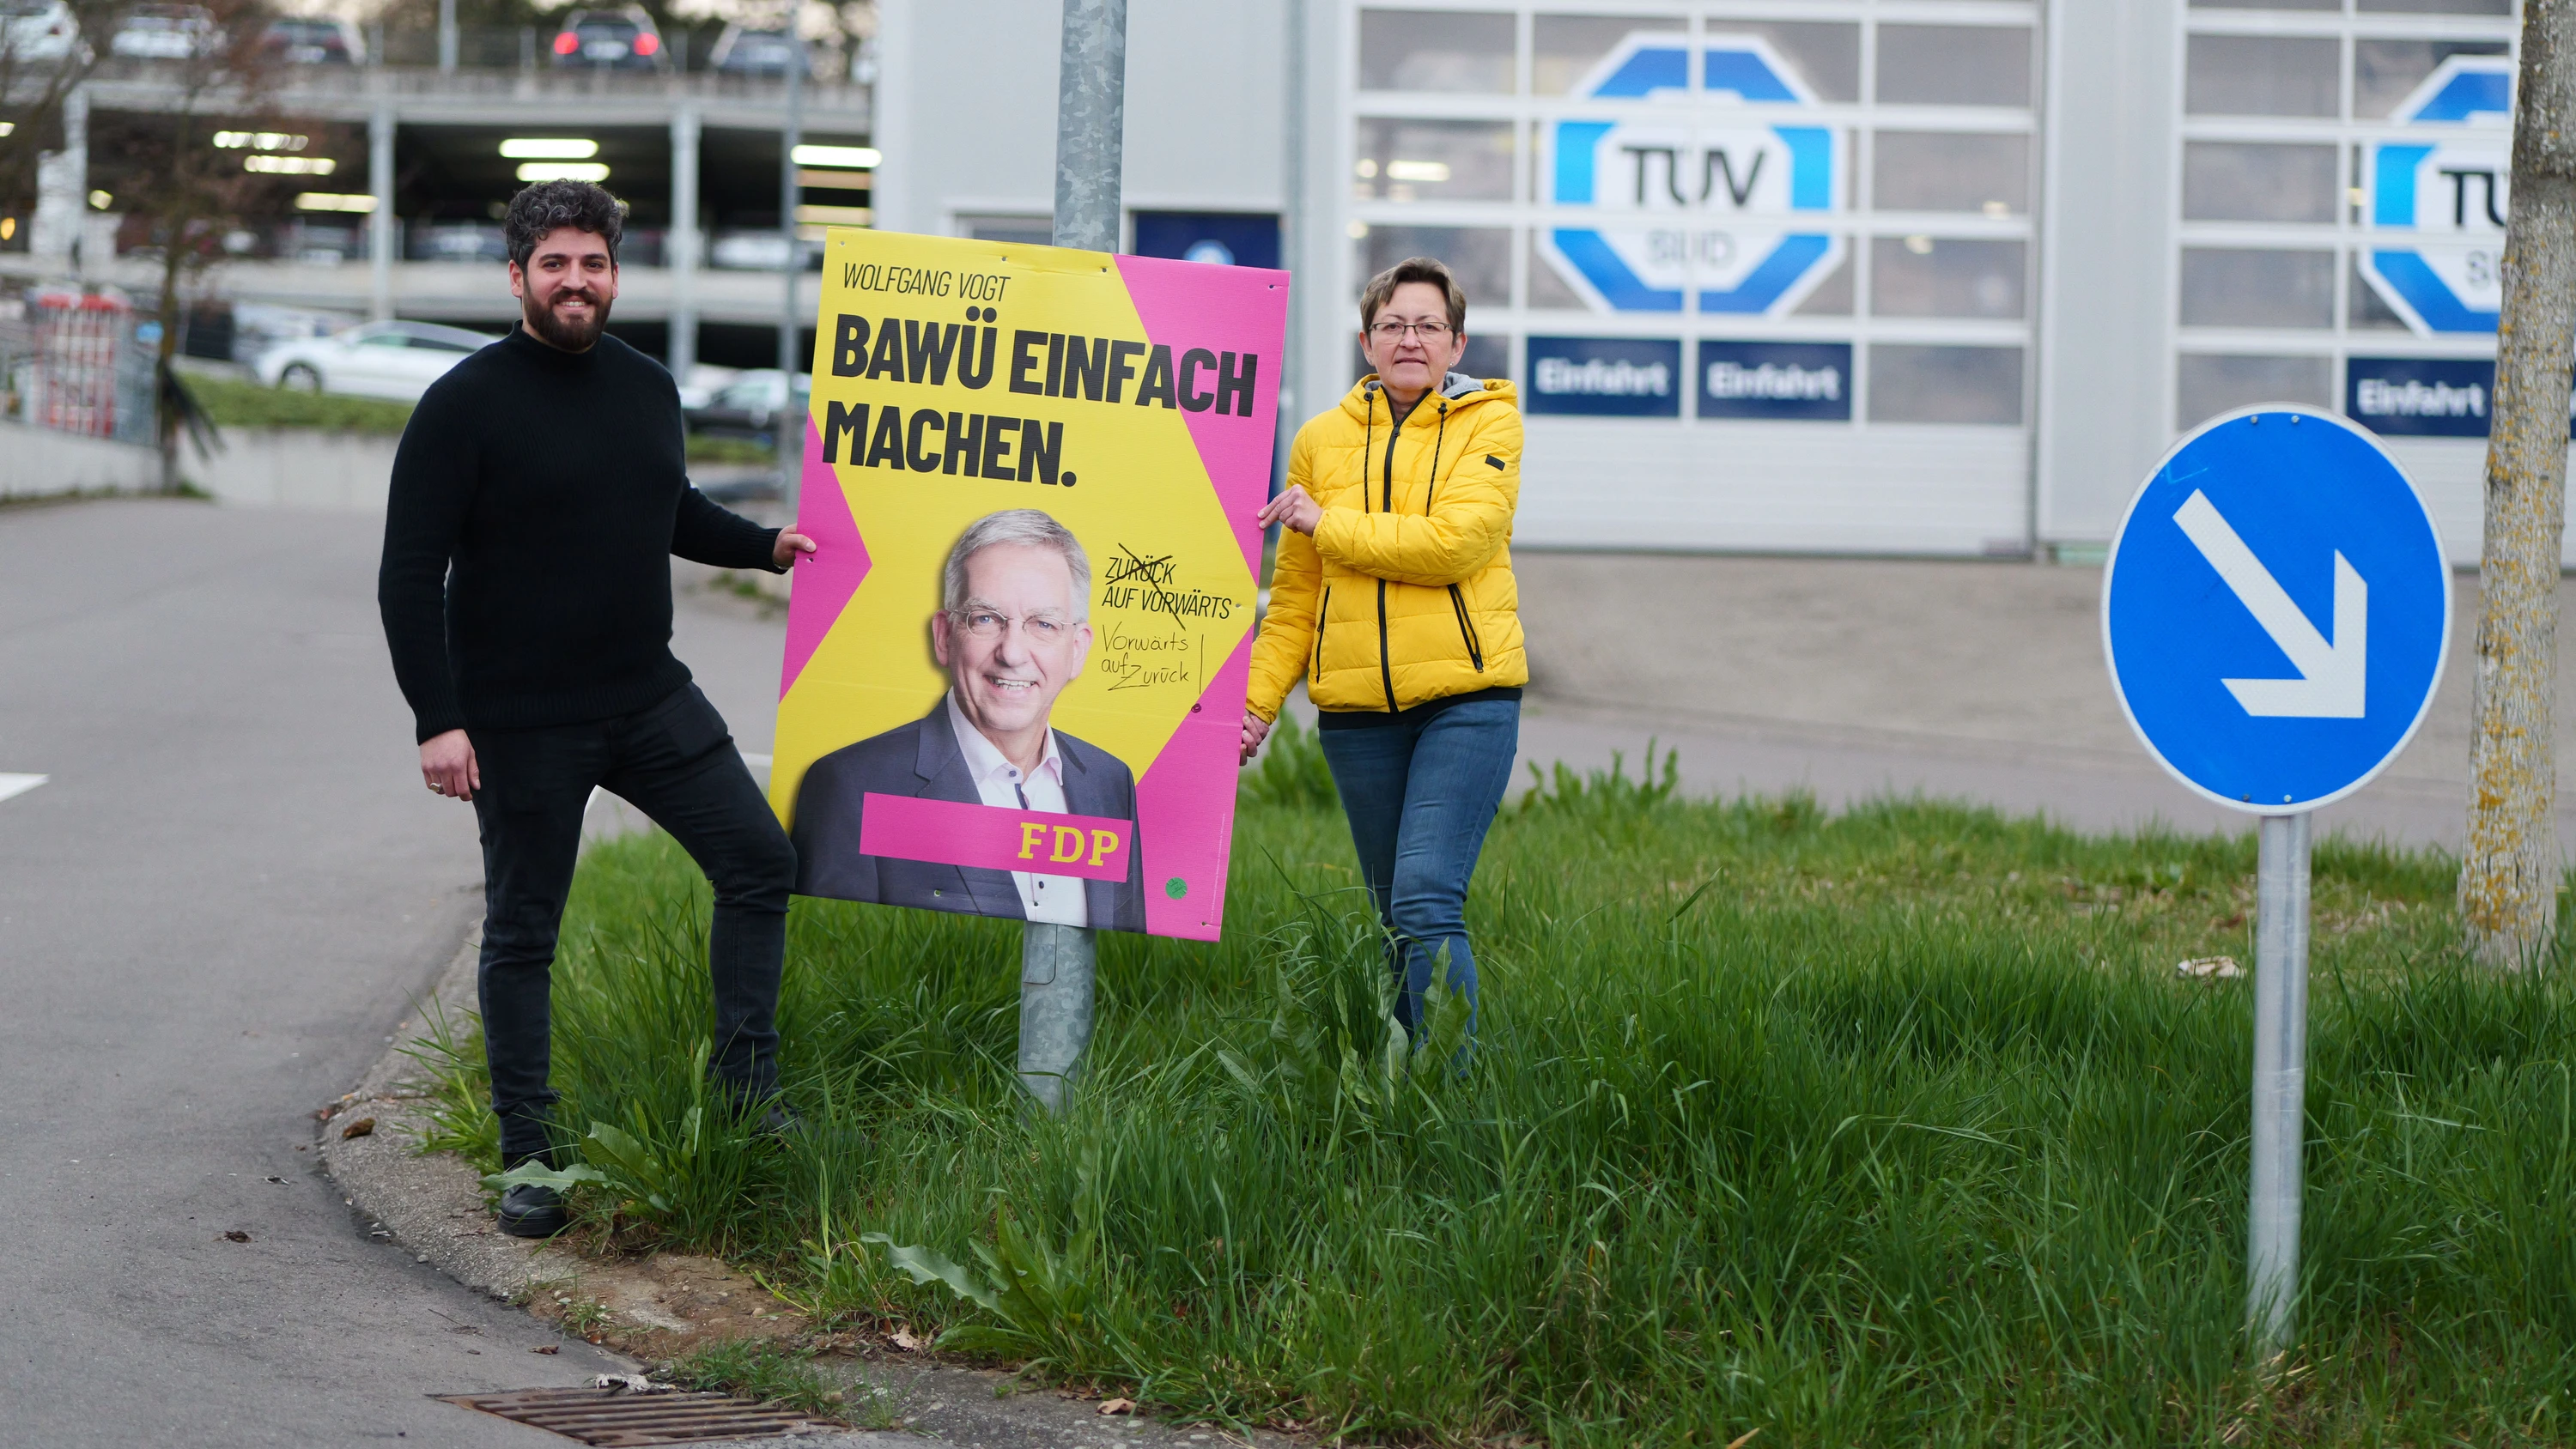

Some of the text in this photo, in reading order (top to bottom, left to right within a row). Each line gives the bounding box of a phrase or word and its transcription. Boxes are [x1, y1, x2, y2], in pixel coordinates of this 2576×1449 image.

[844, 262, 1012, 302] WOLFGANG VOGT
[831, 306, 1258, 418] BAWÜ EINFACH
[1535, 357, 1670, 397] Einfahrt
[1708, 361, 1841, 401] Einfahrt
[2356, 379, 2487, 418] Einfahrt
[822, 400, 1078, 488] MACHEN.
[1105, 555, 1176, 585] ZURÜCK
[1102, 585, 1232, 619] AUF VORWÄRTS
[1102, 621, 1189, 652] Vorwärts
[1101, 652, 1131, 676] auf
[1018, 822, 1119, 866] FDP
